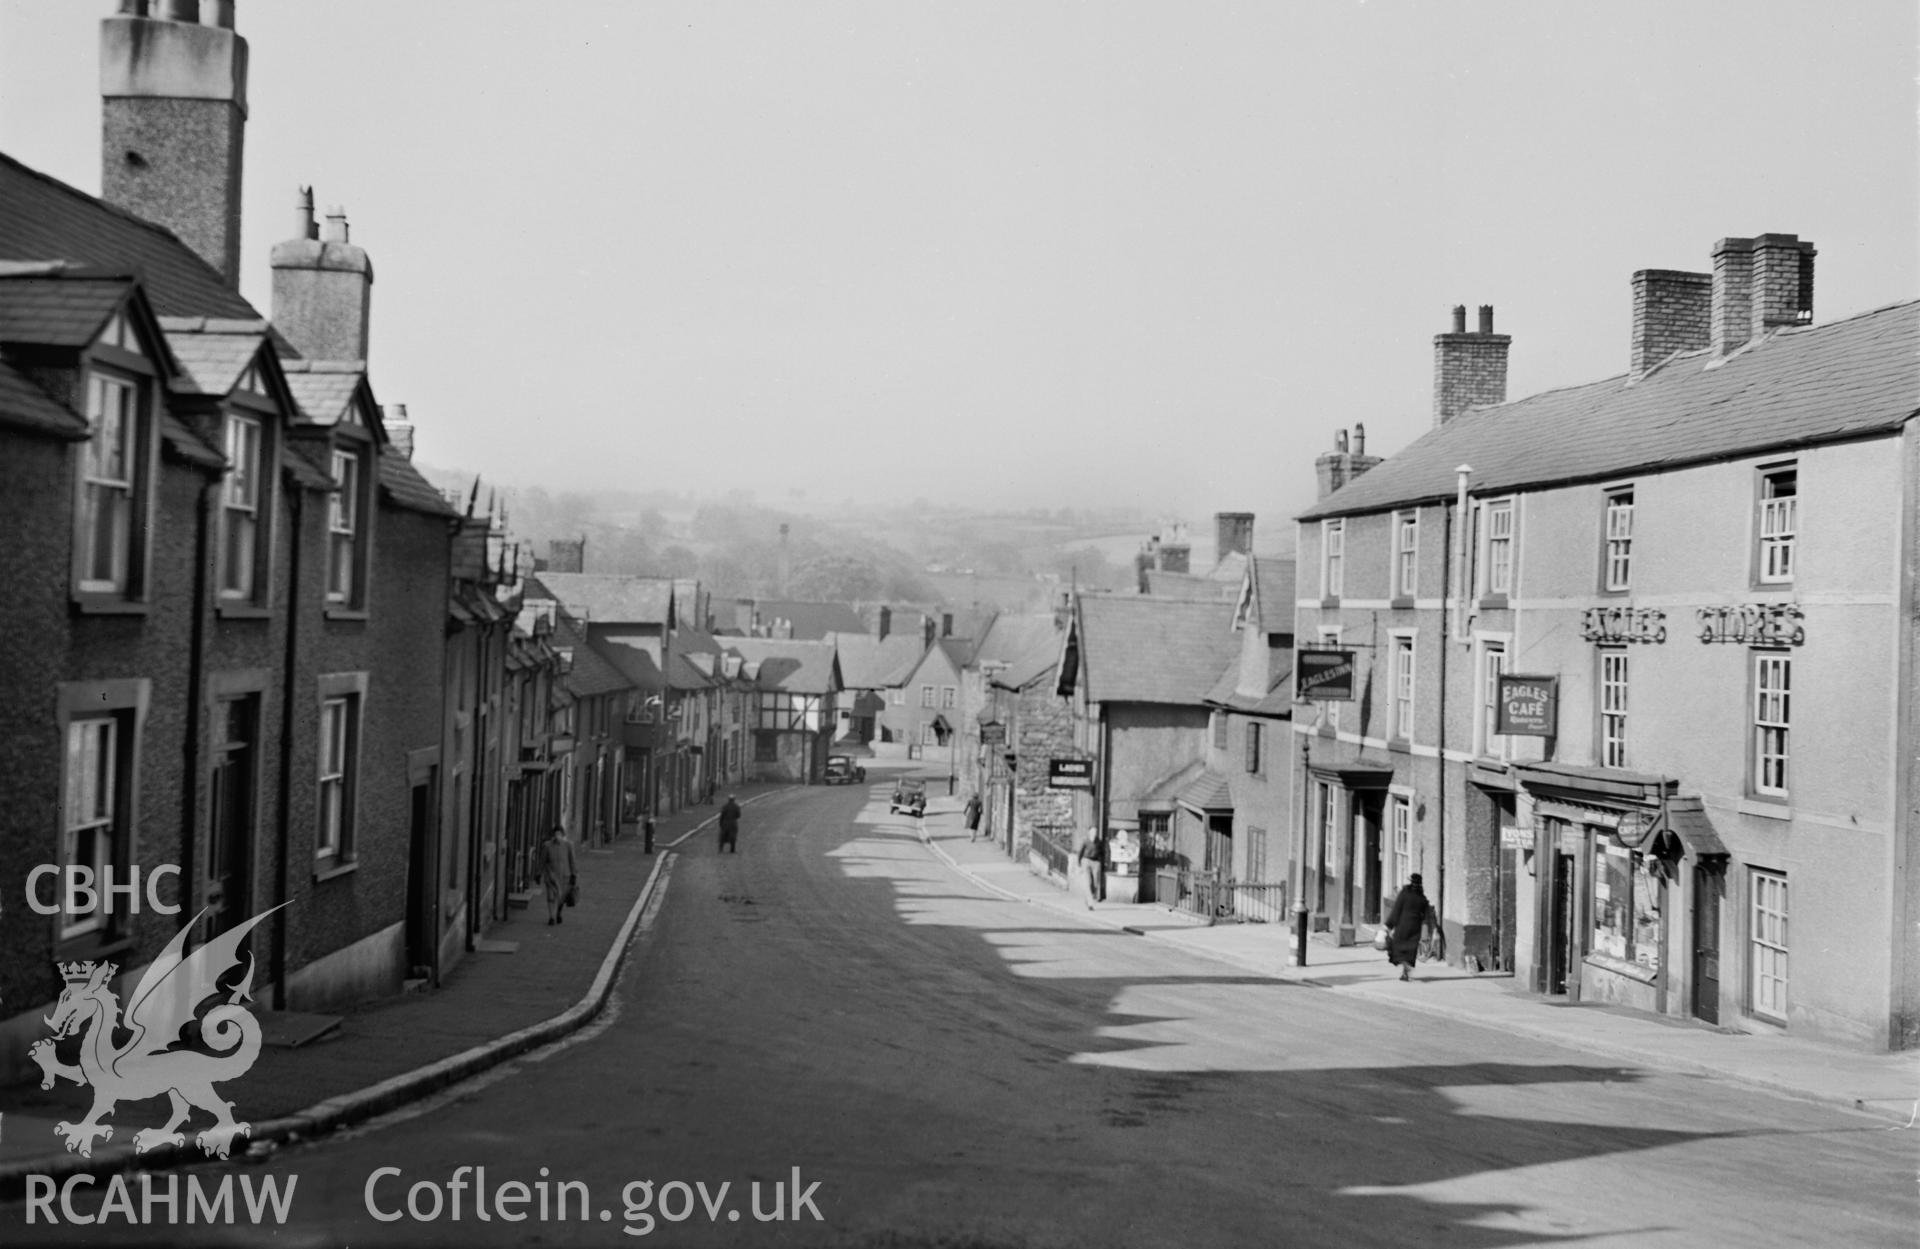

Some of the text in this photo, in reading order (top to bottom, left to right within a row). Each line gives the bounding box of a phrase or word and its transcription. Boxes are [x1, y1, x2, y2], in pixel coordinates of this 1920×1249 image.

[1581, 603, 1806, 647] EAGLES STORES
[1503, 685, 1549, 704] EAGLES
